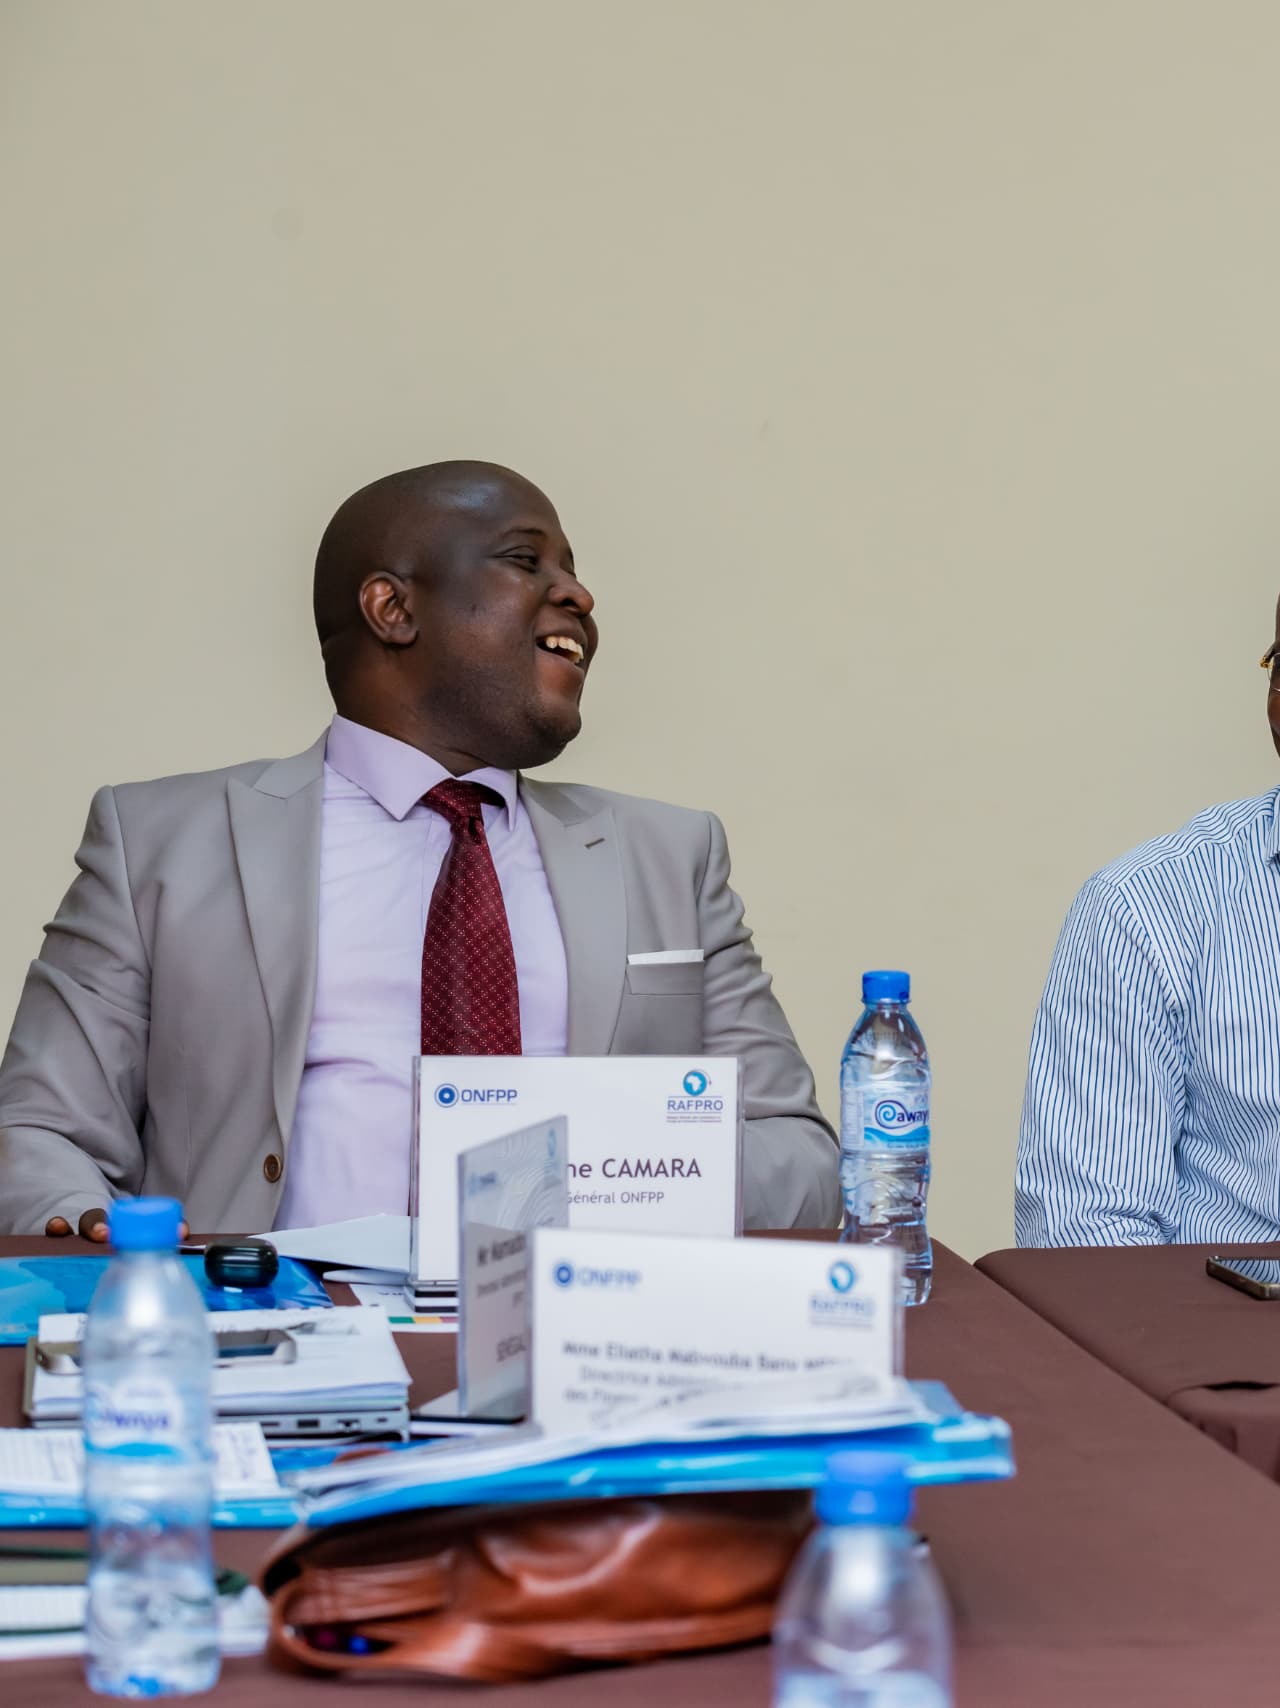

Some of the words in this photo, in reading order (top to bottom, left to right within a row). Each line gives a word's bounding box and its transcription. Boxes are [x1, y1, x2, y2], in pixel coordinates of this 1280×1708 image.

[461, 1088, 517, 1103] ONFPP
[667, 1099, 724, 1111] RAFPRO
[602, 1158, 702, 1178] CAMARA
[620, 1191, 665, 1204] ONFPP
